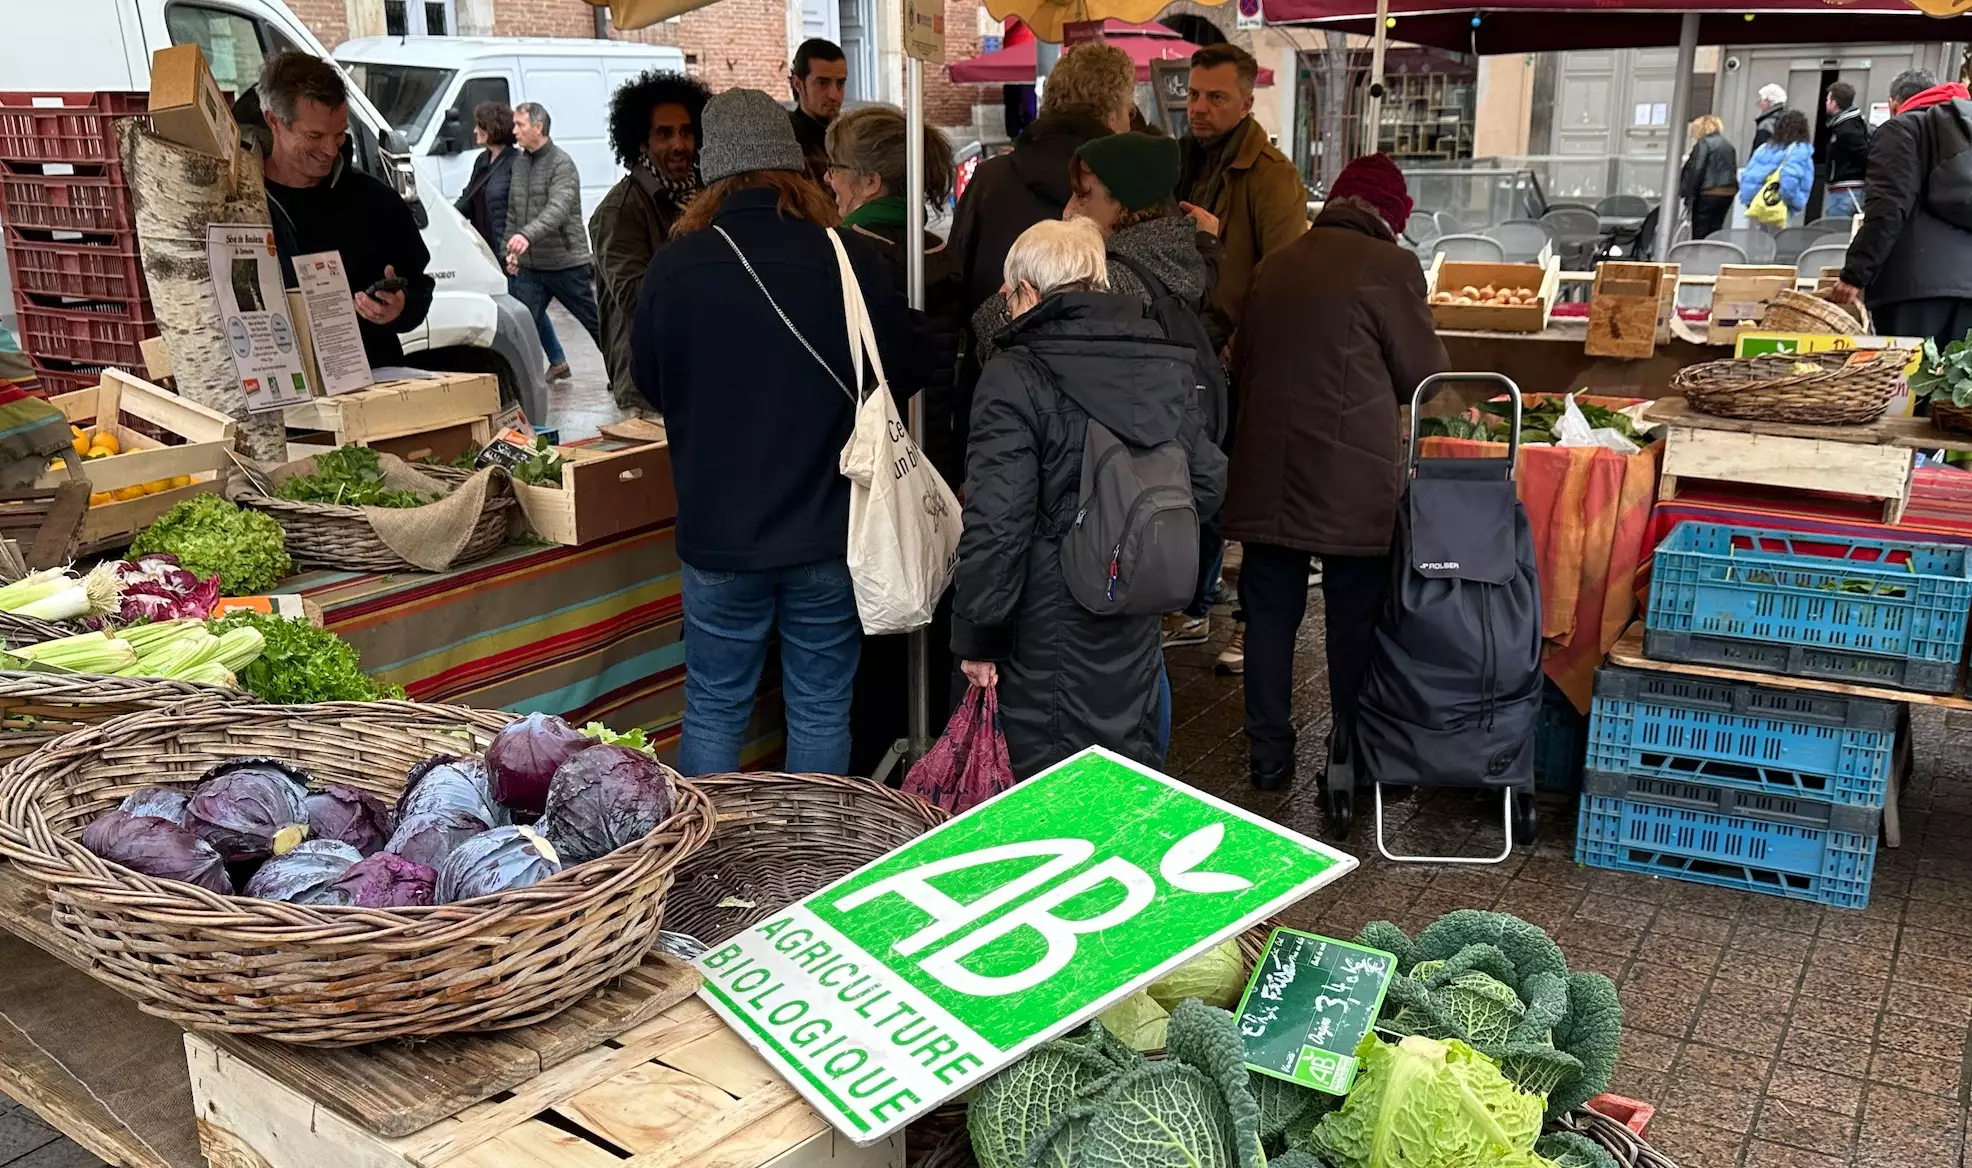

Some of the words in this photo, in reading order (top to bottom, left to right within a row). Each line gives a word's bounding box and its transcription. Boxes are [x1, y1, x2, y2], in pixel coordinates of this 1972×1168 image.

[888, 420, 905, 442] Ce
[832, 838, 1156, 996] AB
[701, 943, 922, 1124] BIOLOGIQUE
[755, 916, 985, 1086] AGRICULTURE
[1308, 1016, 1334, 1046] Origine
[1308, 1056, 1337, 1086] AB
